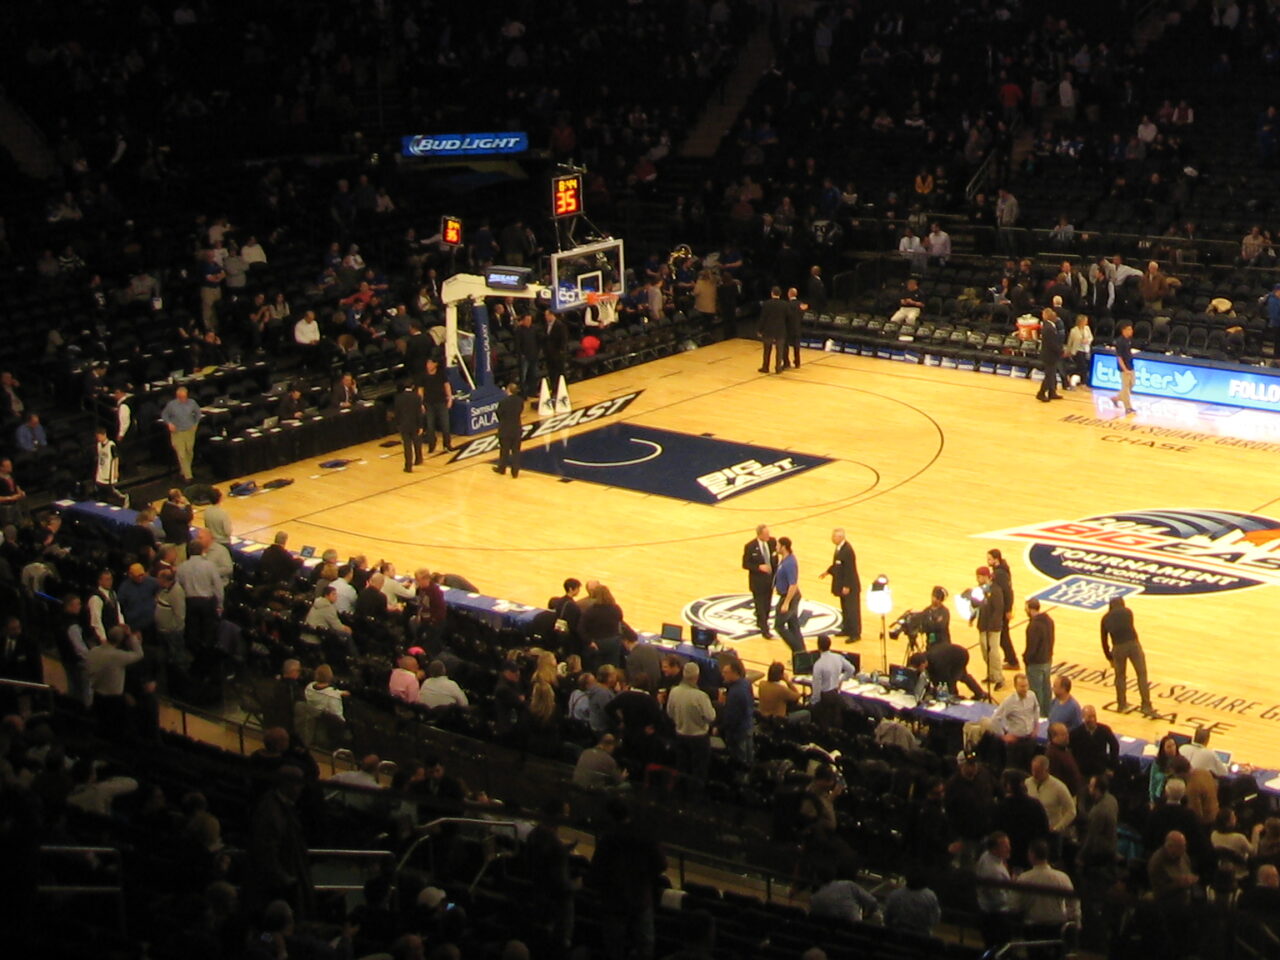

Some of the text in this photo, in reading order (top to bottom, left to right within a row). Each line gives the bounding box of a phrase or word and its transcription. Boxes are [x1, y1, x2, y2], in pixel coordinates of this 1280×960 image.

[558, 178, 577, 192] 8:44
[556, 189, 577, 214] 35
[1059, 414, 1138, 432] MADISON
[1141, 425, 1213, 443] SQUARE
[1100, 434, 1197, 453] CHASE
[696, 459, 764, 487] BIG
[706, 457, 798, 496] EAST
[1042, 523, 1157, 546] BIG
[1091, 517, 1174, 535] 2014
[1050, 546, 1240, 587] TOURNAMENT
[1062, 559, 1104, 573] NEW
[1109, 565, 1152, 582] YORK
[1152, 573, 1193, 587] CITY
[1157, 683, 1263, 715] SQUARE
